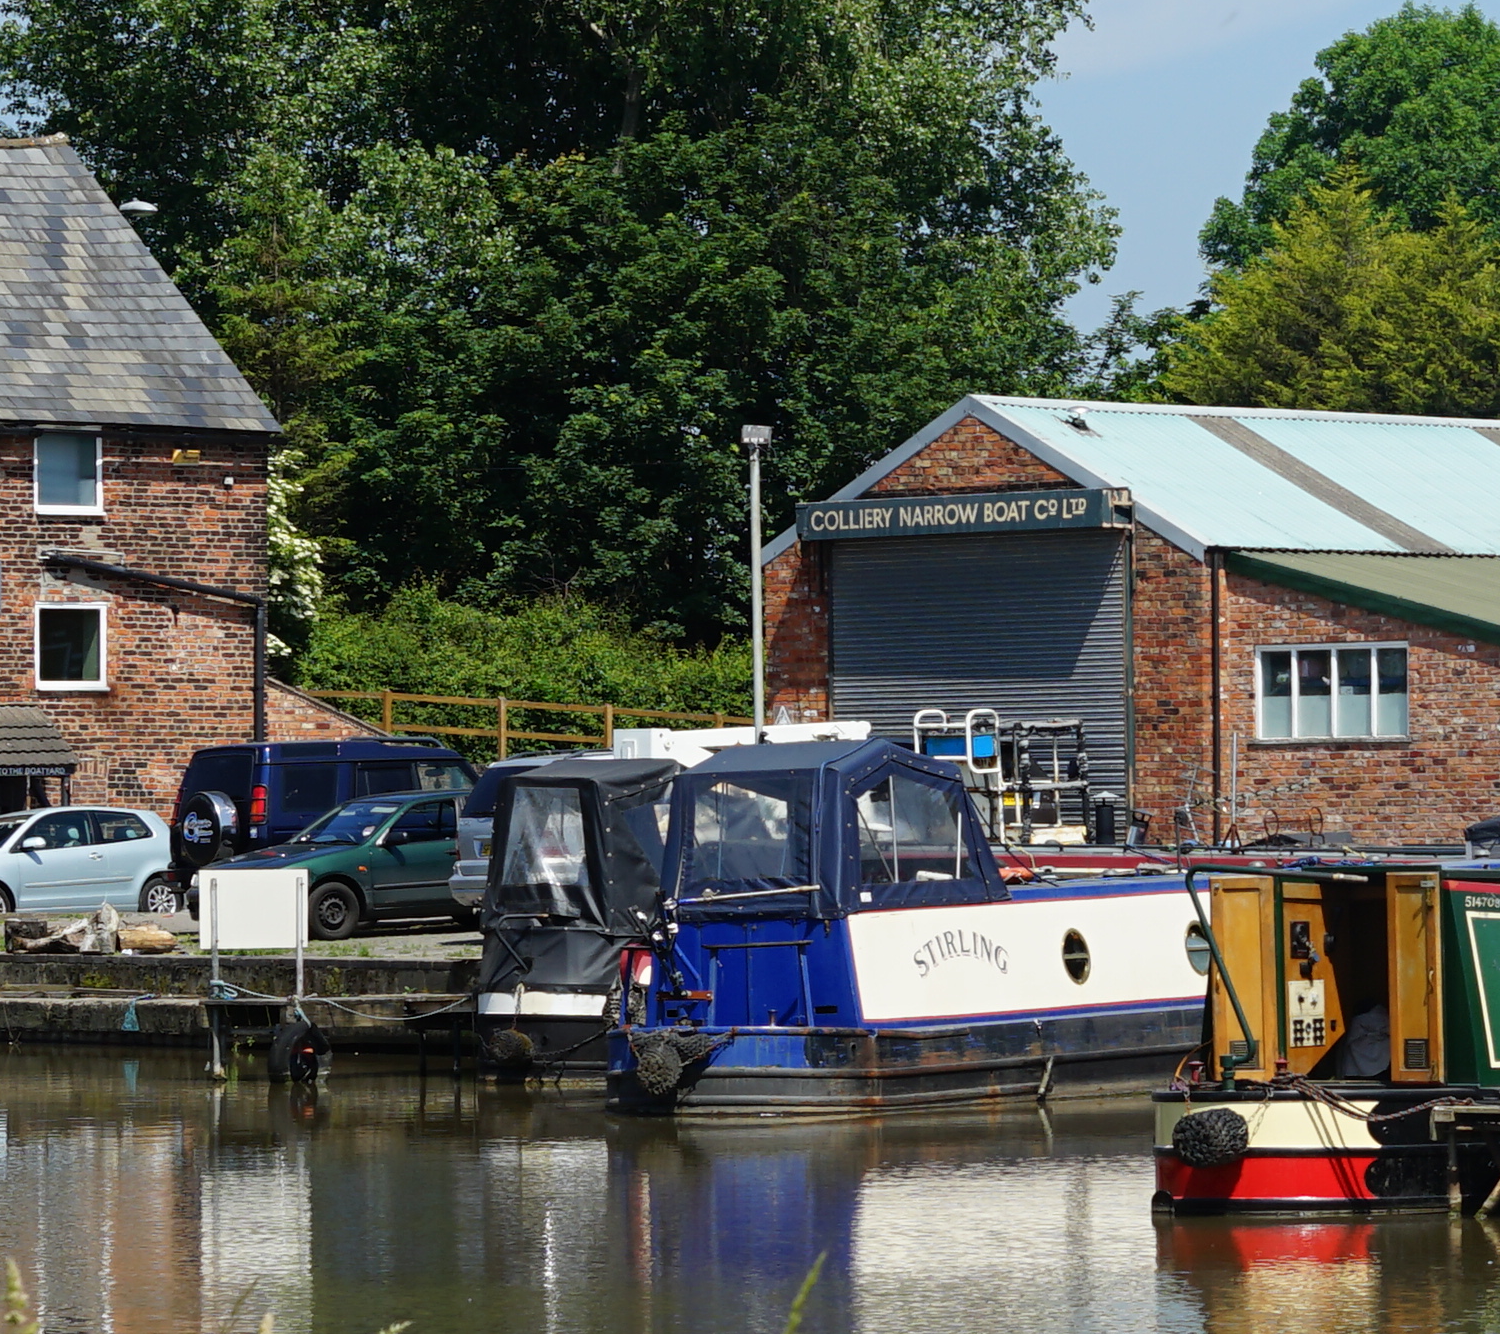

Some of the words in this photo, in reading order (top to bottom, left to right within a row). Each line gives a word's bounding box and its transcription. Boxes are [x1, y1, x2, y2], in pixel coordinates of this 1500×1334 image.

[810, 507, 894, 531] COLLIERY
[899, 503, 980, 527] NARROW
[983, 500, 1030, 522] BOAT
[913, 929, 1009, 978] STIRLING
